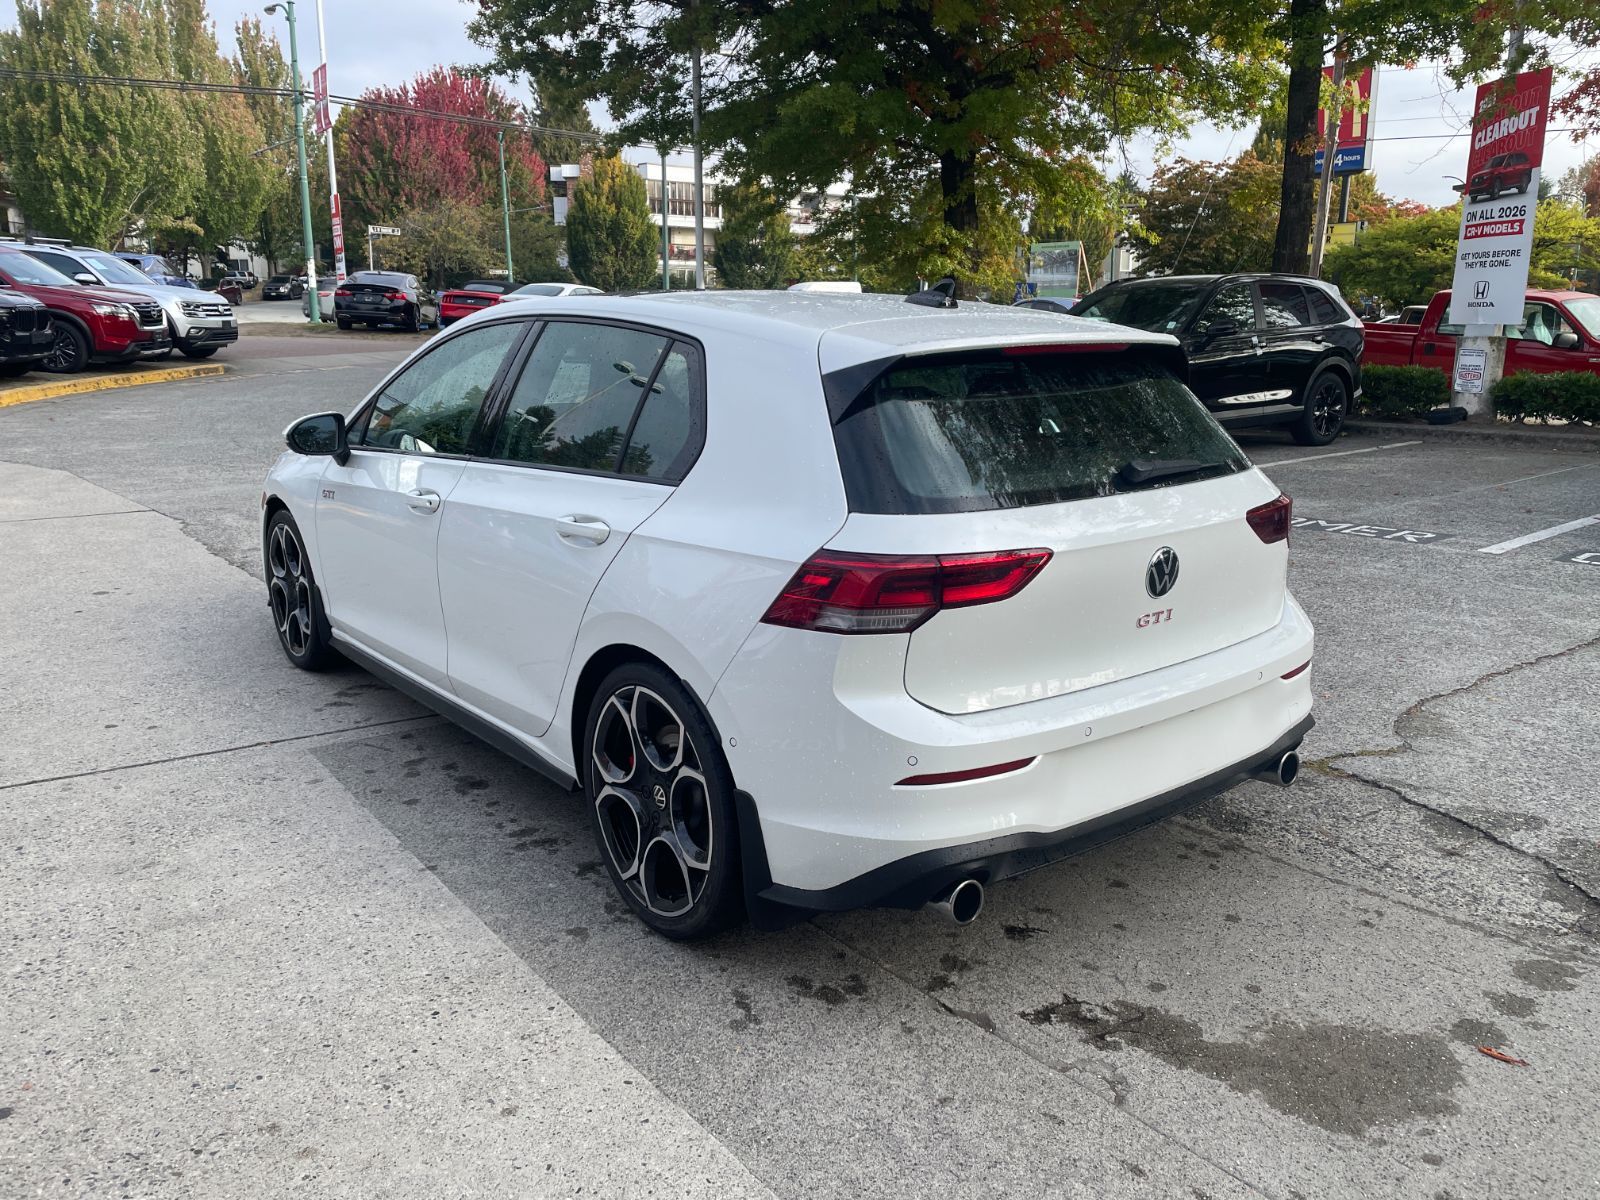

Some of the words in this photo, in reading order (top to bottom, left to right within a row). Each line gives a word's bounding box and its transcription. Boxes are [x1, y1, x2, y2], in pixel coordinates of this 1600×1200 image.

[1474, 106, 1540, 150] CLEAROUT
[1466, 210, 1478, 222] ON
[1480, 208, 1495, 220] ALL
[1498, 205, 1527, 218] 2026
[1466, 226, 1483, 236] CR-V
[1483, 222, 1520, 235] MODELS
[1461, 252, 1471, 260] GET
[1472, 250, 1491, 260] YOURS
[1491, 249, 1521, 258] BEFORE
[1465, 260, 1487, 269] THEY'RE
[1489, 259, 1512, 268] GONE.
[1136, 608, 1174, 629] GTI
